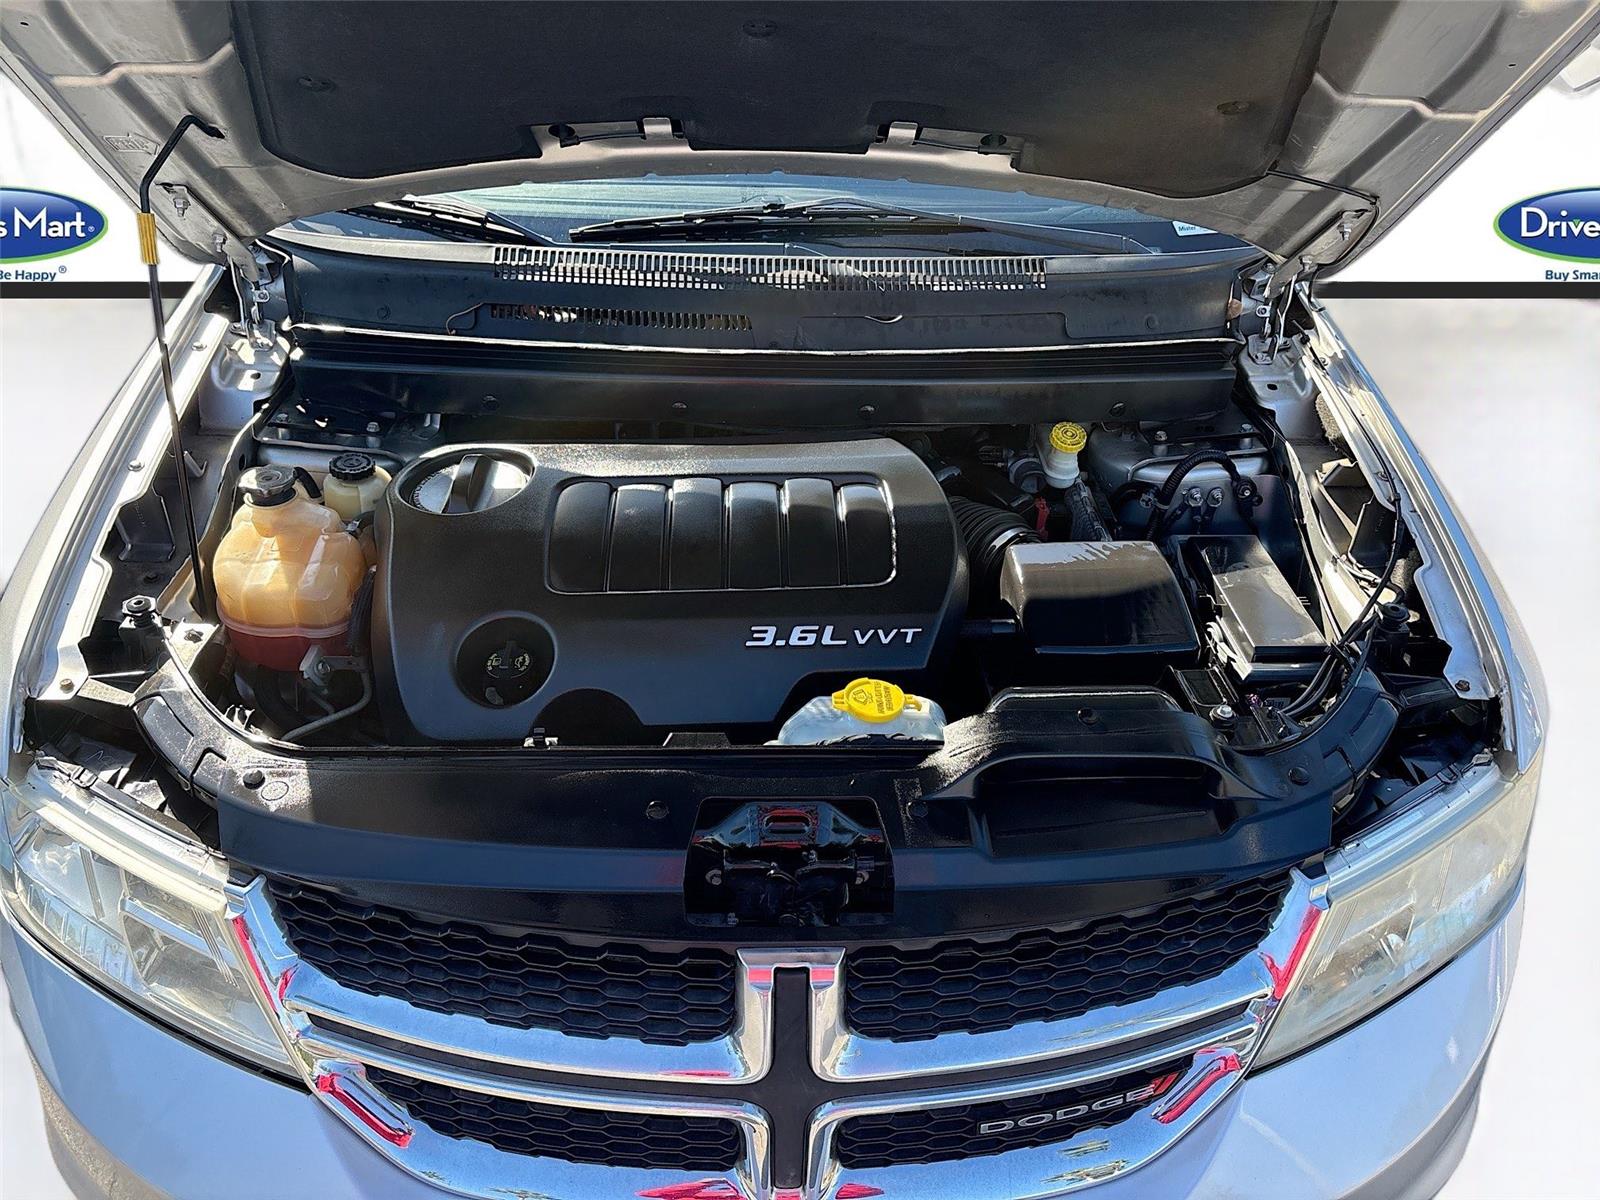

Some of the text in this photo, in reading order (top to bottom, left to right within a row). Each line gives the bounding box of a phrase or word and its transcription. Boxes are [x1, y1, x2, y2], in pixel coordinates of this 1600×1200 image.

[14, 206, 86, 238] Mart
[1521, 206, 1600, 238] Drive
[15, 270, 57, 281] Happy
[1545, 270, 1570, 281] Buy
[745, 625, 922, 646] 3.6L VVT
[979, 1083, 1156, 1134] DODGE
